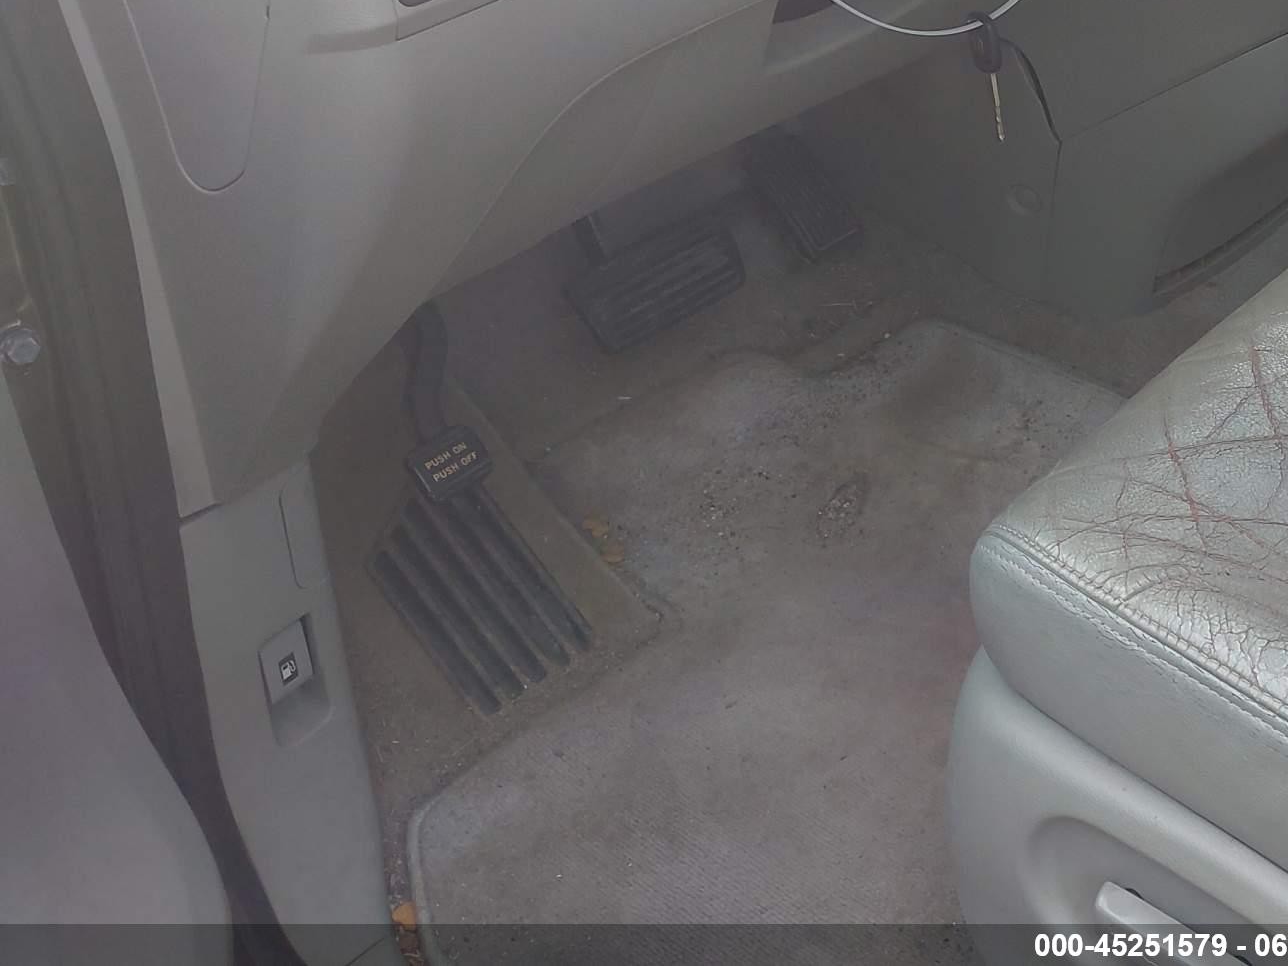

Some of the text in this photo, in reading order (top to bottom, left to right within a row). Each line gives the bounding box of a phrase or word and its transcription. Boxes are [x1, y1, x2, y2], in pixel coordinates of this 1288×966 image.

[425, 442, 467, 470] PUSH ON
[432, 451, 477, 482] PUSH OFF
